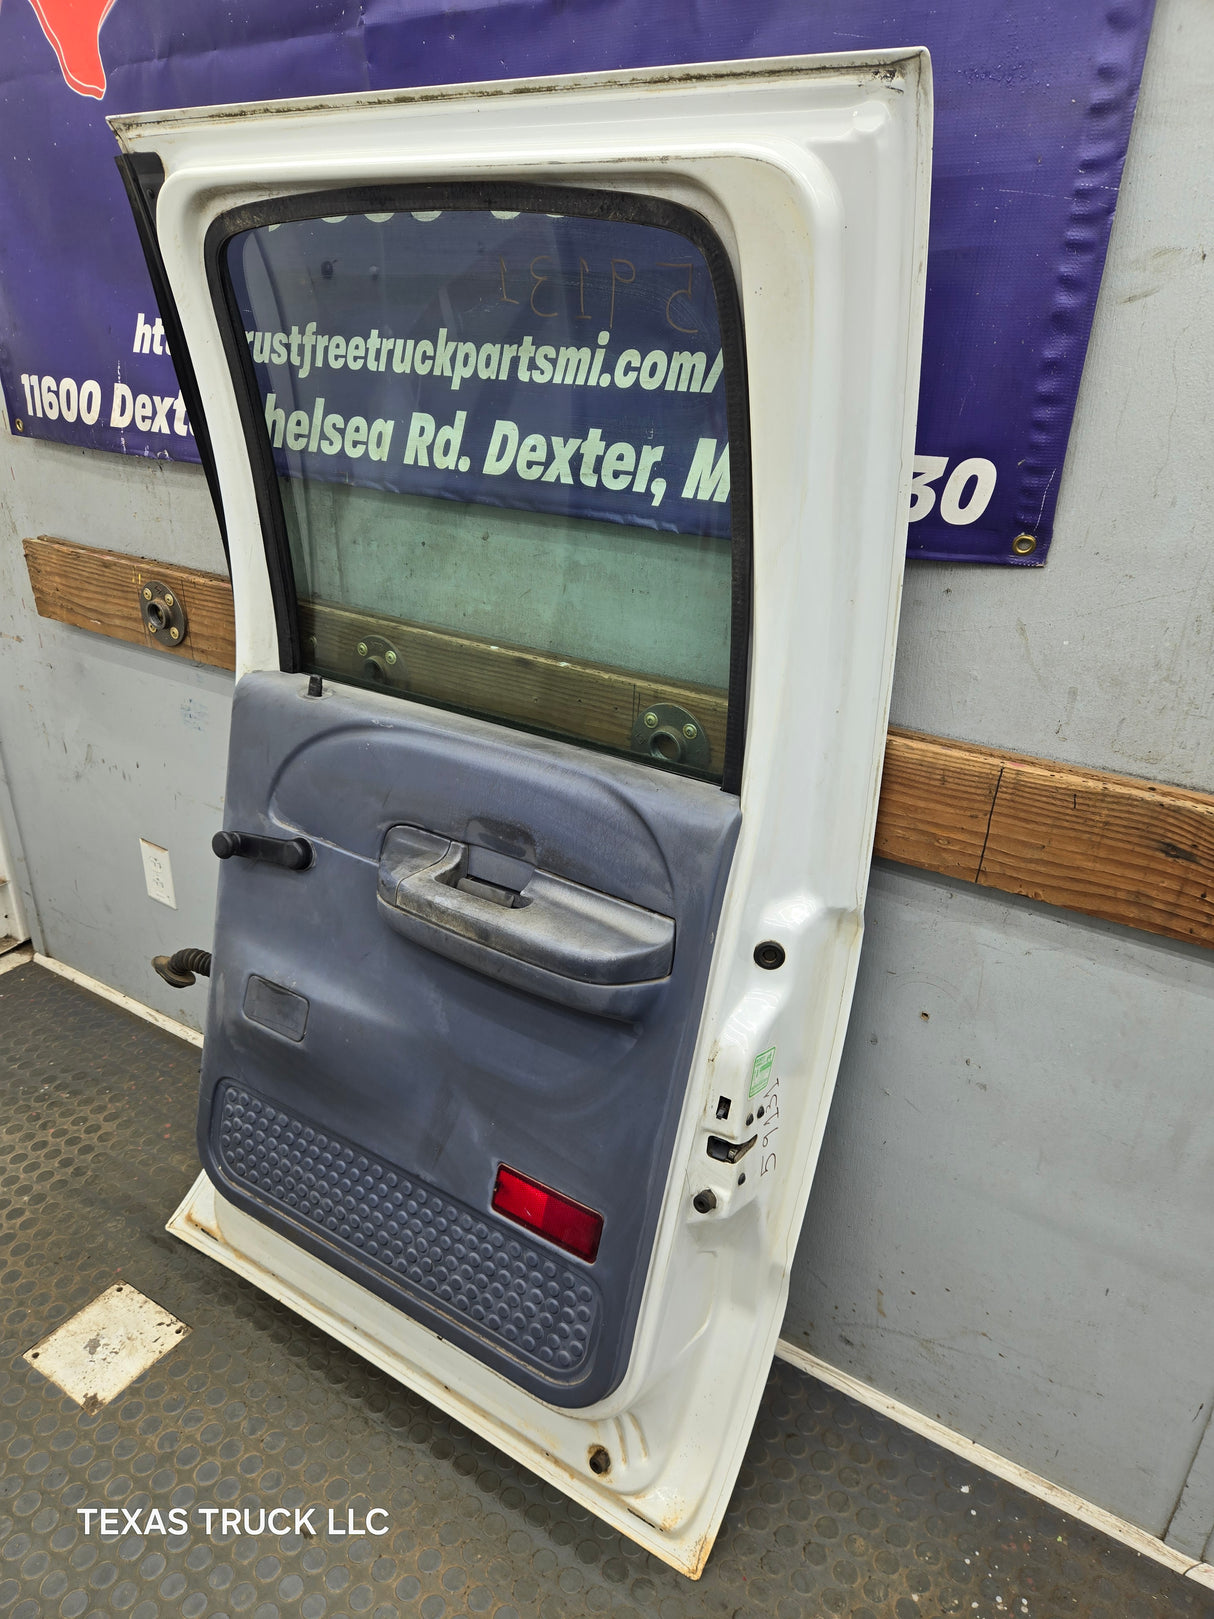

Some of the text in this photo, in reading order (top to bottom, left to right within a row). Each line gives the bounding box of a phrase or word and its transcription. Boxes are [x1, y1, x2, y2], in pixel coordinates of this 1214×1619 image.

[132, 313, 172, 355] ht
[20, 373, 101, 425] 11600
[110, 382, 195, 437] Dext
[403, 410, 471, 472] Rd.
[482, 420, 666, 506] Dexter,
